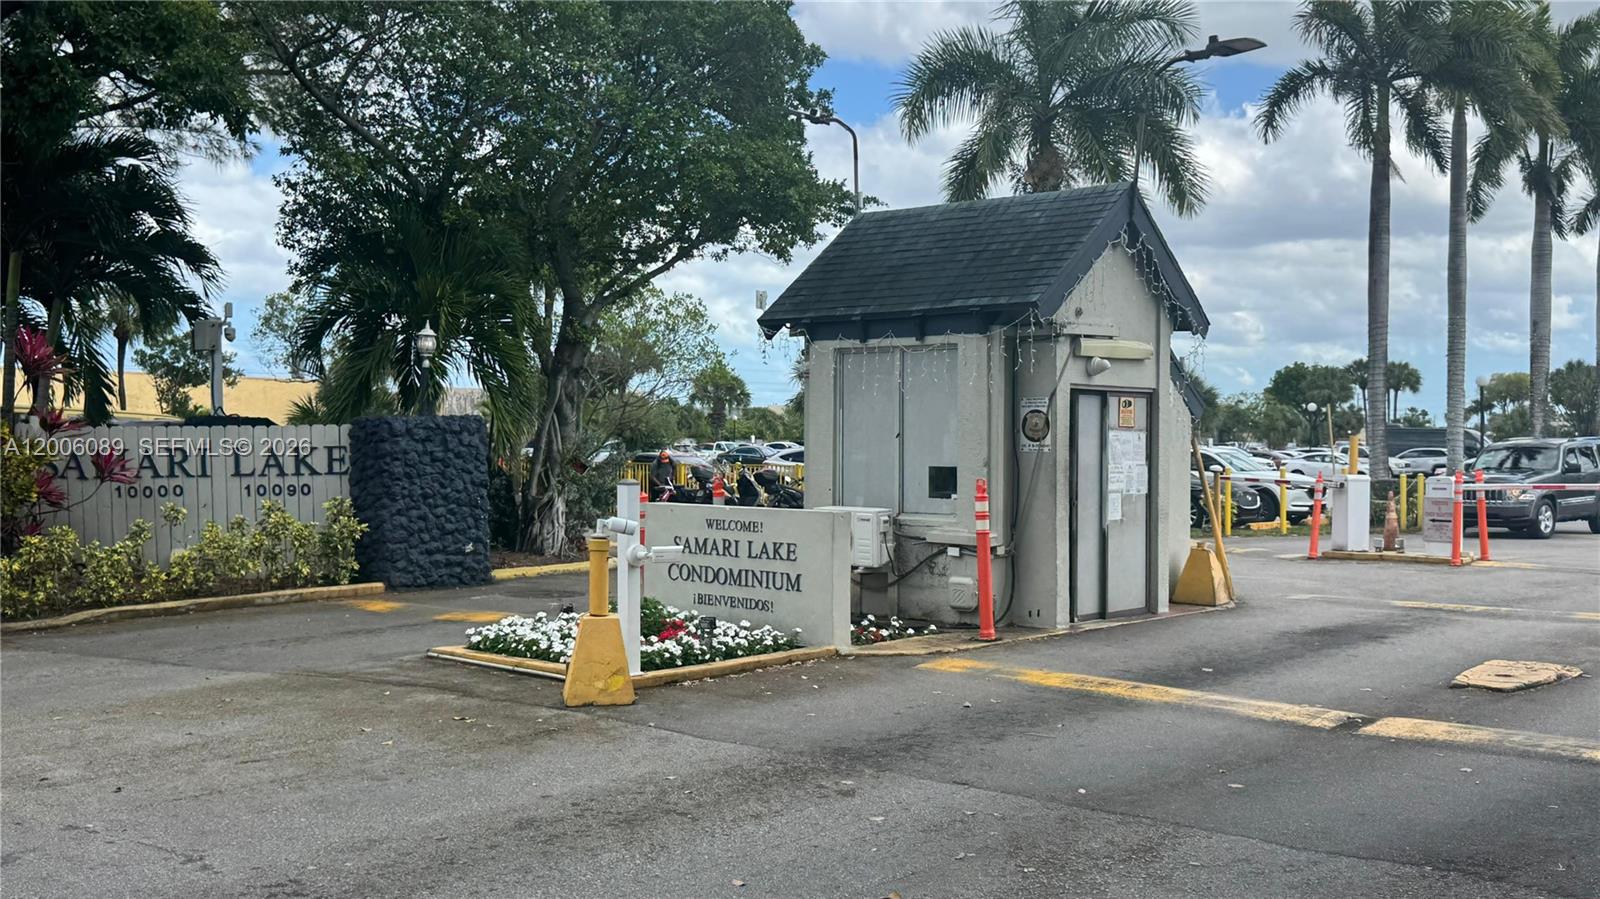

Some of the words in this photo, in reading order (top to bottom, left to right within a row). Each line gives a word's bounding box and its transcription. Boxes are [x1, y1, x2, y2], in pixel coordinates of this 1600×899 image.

[43, 447, 212, 480] AARI
[230, 445, 350, 477] LAKE
[114, 484, 184, 498] 10000
[244, 483, 311, 497] 10090
[705, 518, 764, 533] WELCOME!
[746, 540, 798, 562] LAKE
[667, 562, 803, 593] CONDOMINIUM
[692, 592, 775, 613] ¡BIENVENIDOS!
